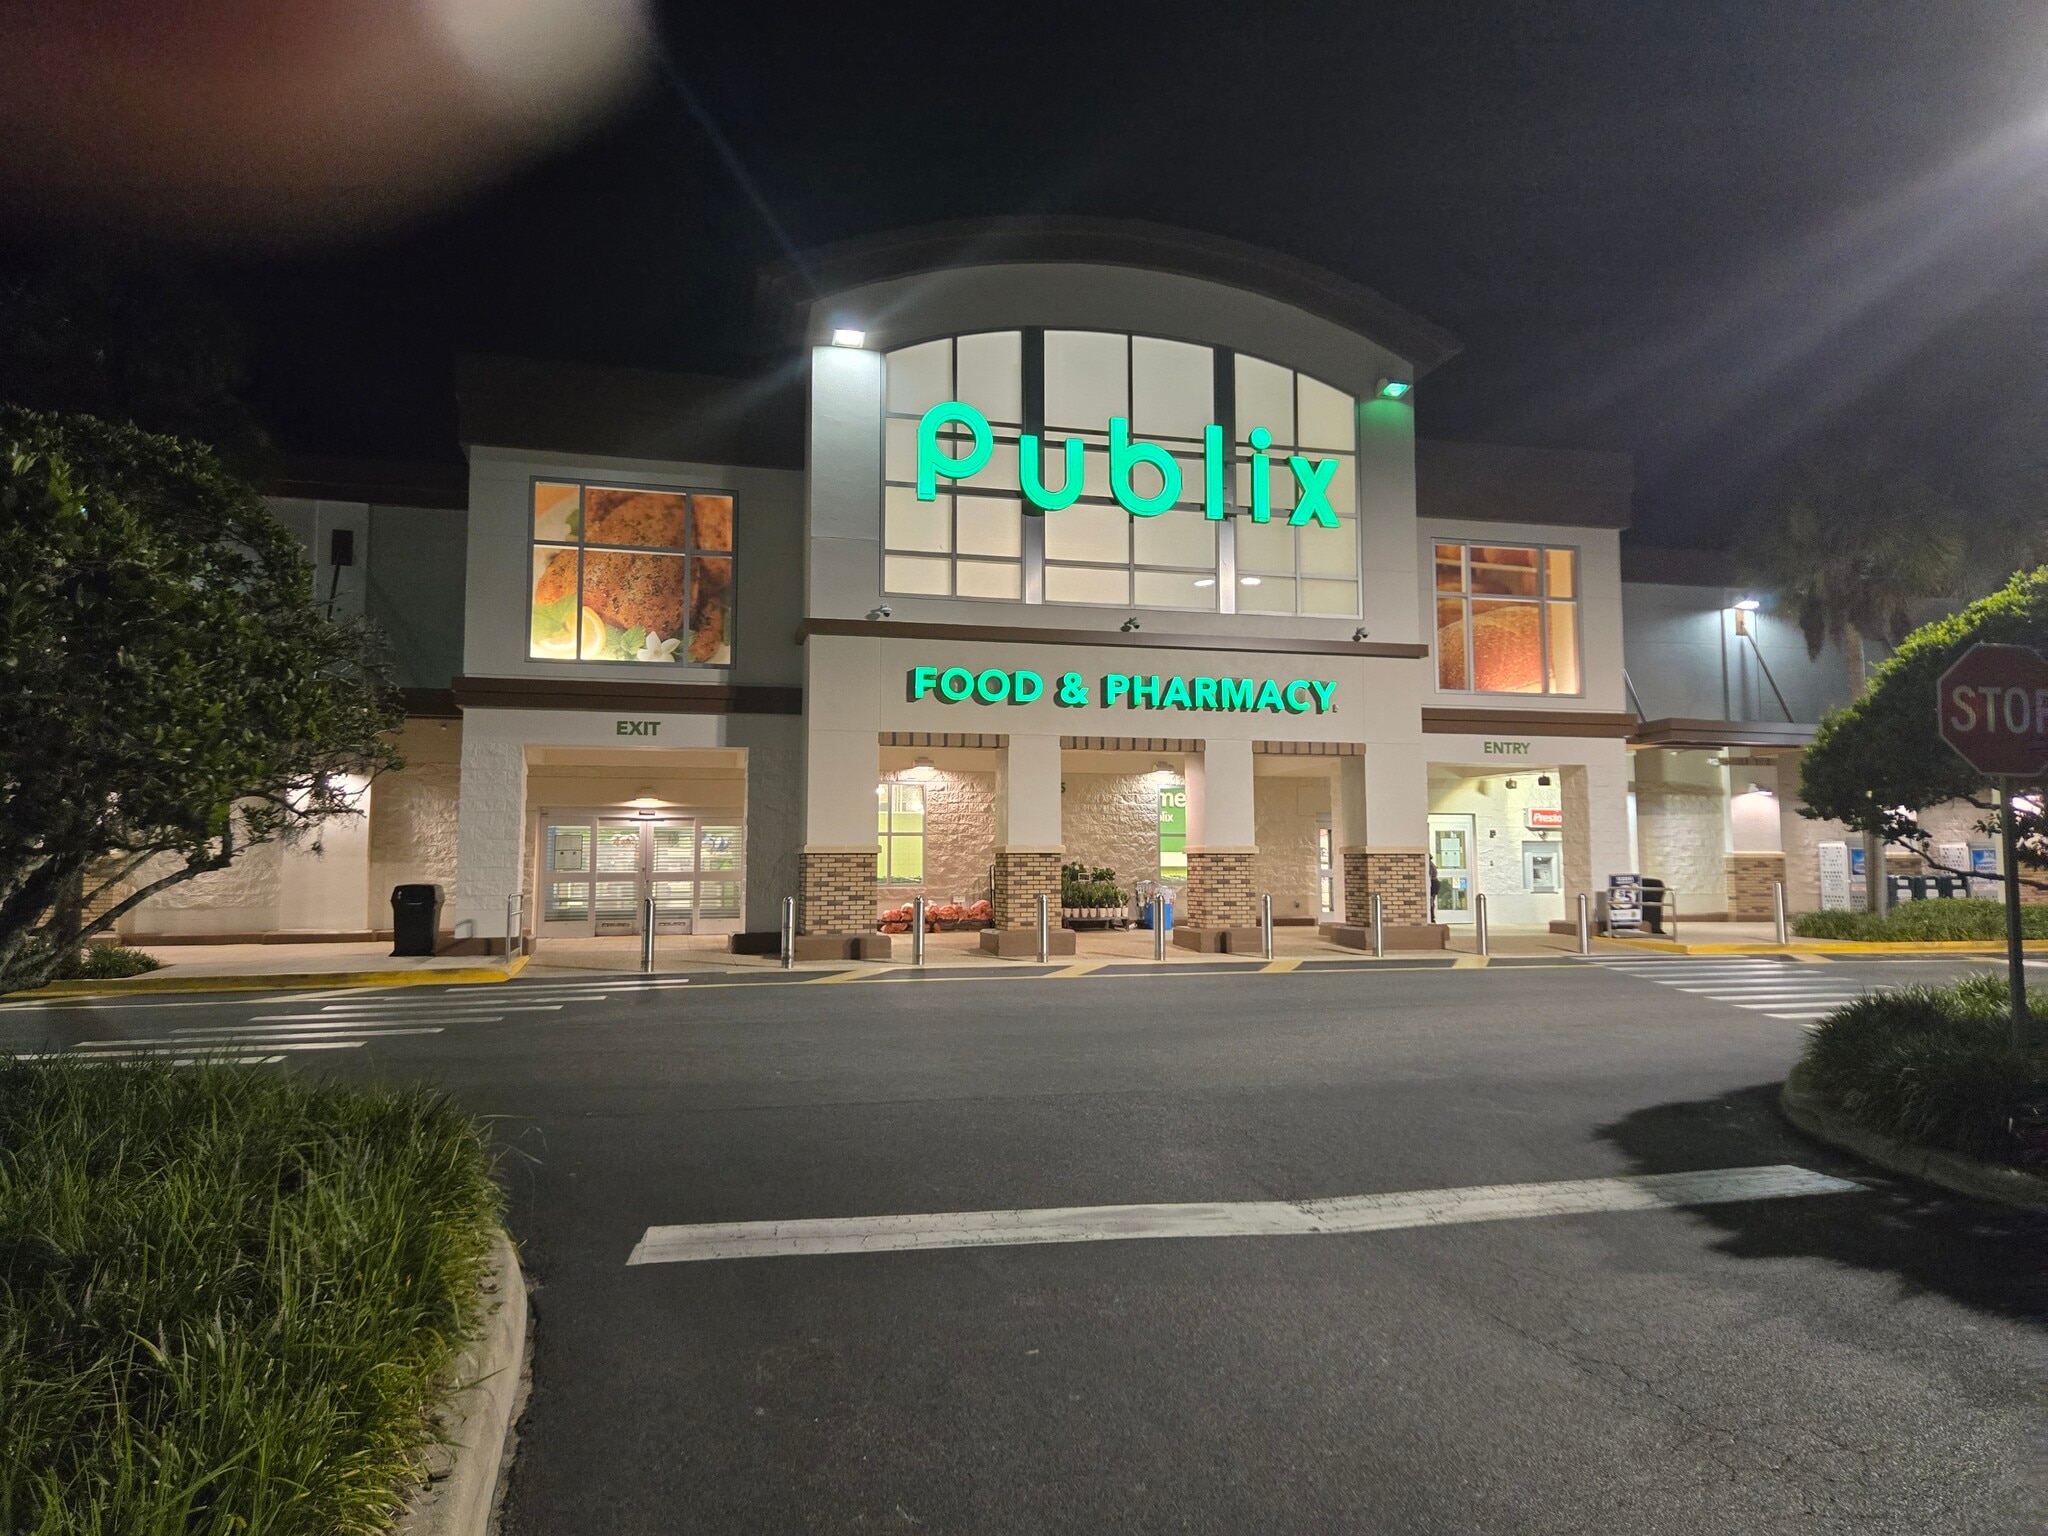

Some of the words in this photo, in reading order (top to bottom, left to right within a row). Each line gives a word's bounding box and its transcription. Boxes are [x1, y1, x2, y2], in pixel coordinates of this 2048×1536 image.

[916, 400, 1340, 528] Publix
[914, 666, 1044, 702] FOOD
[1060, 671, 1089, 705] &
[1106, 673, 1337, 711] PHARMACY
[616, 720, 661, 736] EXIT
[1484, 741, 1531, 755] ENTRY
